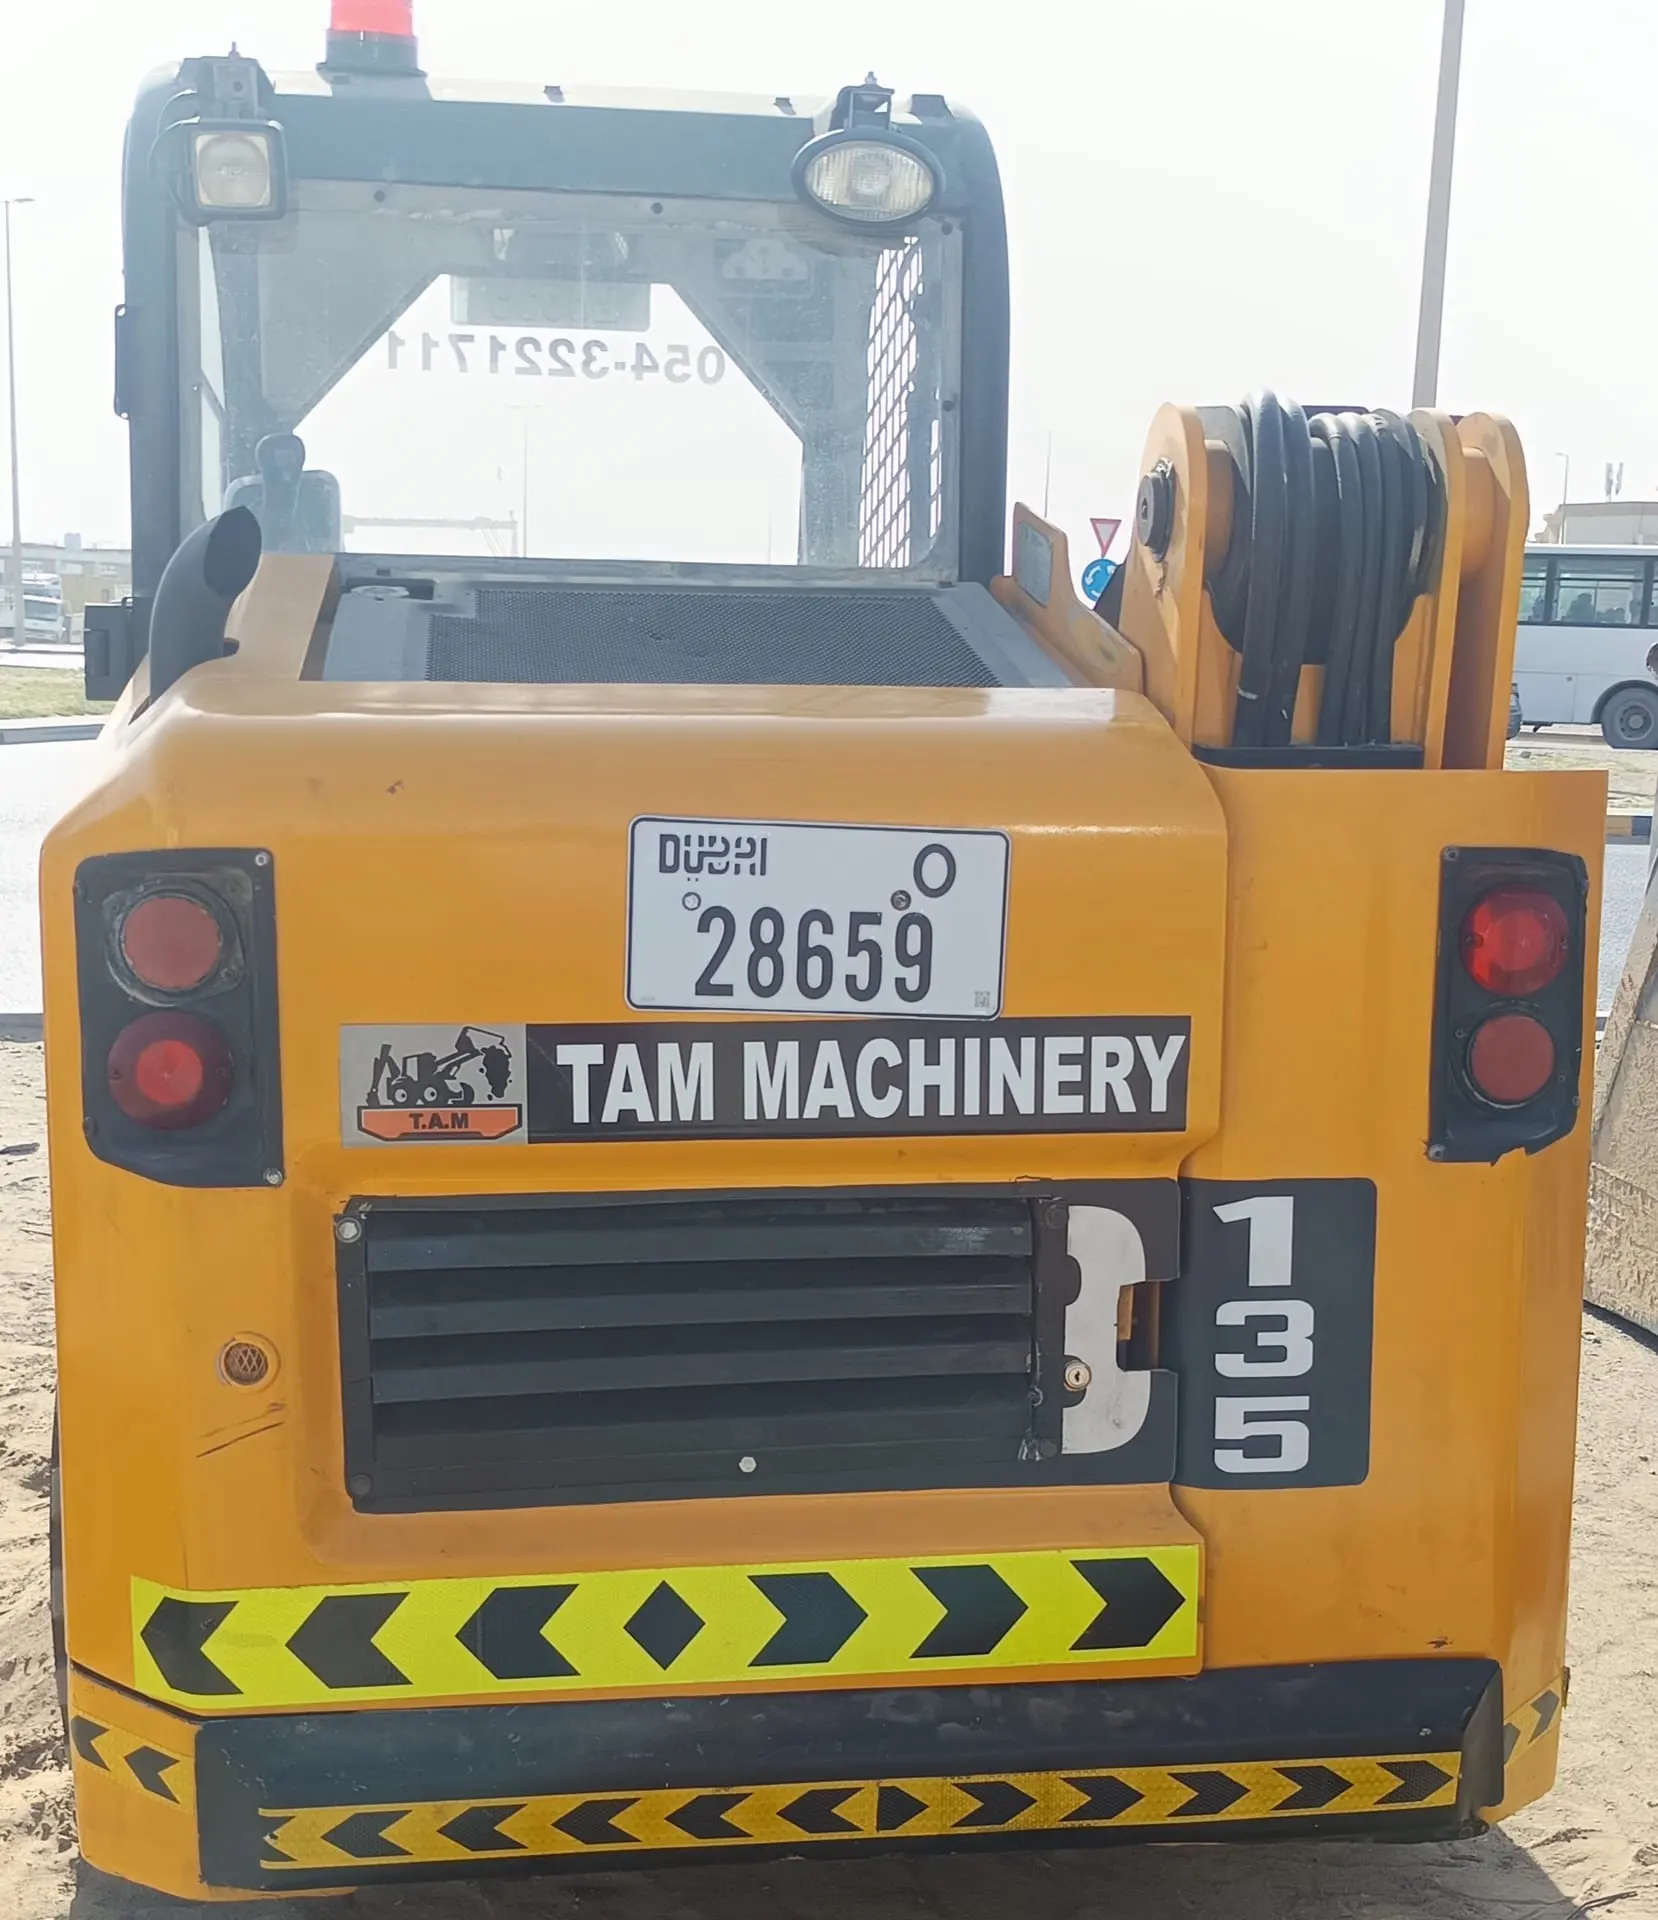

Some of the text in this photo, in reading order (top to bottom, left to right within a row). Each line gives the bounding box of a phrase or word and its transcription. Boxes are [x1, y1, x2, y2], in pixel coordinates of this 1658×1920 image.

[659, 833, 768, 877] DUBAI
[694, 905, 934, 1003] 28659
[556, 1034, 1187, 1124] TAM MACHINERY
[408, 1112, 469, 1130] T.A.M
